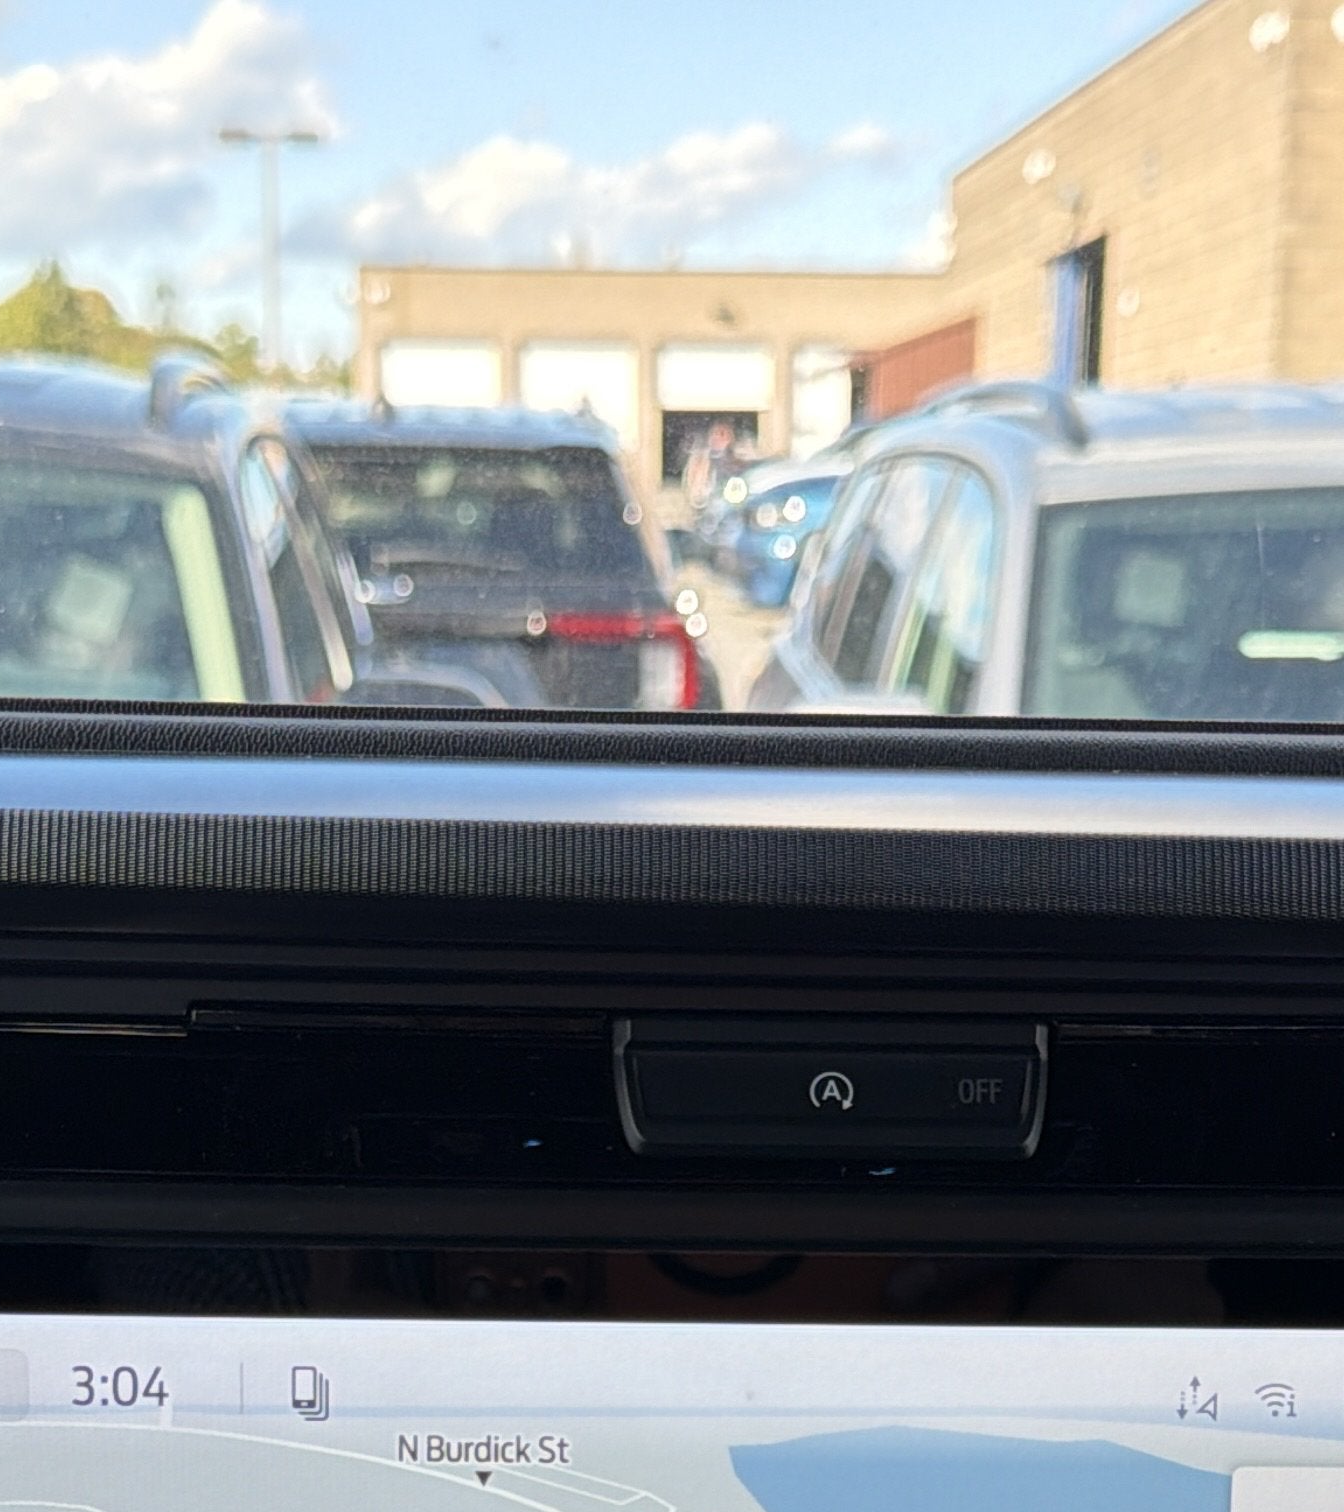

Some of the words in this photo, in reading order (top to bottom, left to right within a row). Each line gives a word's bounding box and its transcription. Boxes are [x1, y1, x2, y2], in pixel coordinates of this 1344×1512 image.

[958, 1078, 1003, 1104] OFF
[71, 1365, 170, 1407] 3:04
[398, 1434, 419, 1463] N
[426, 1434, 532, 1464] Burdick
[538, 1435, 571, 1464] St
